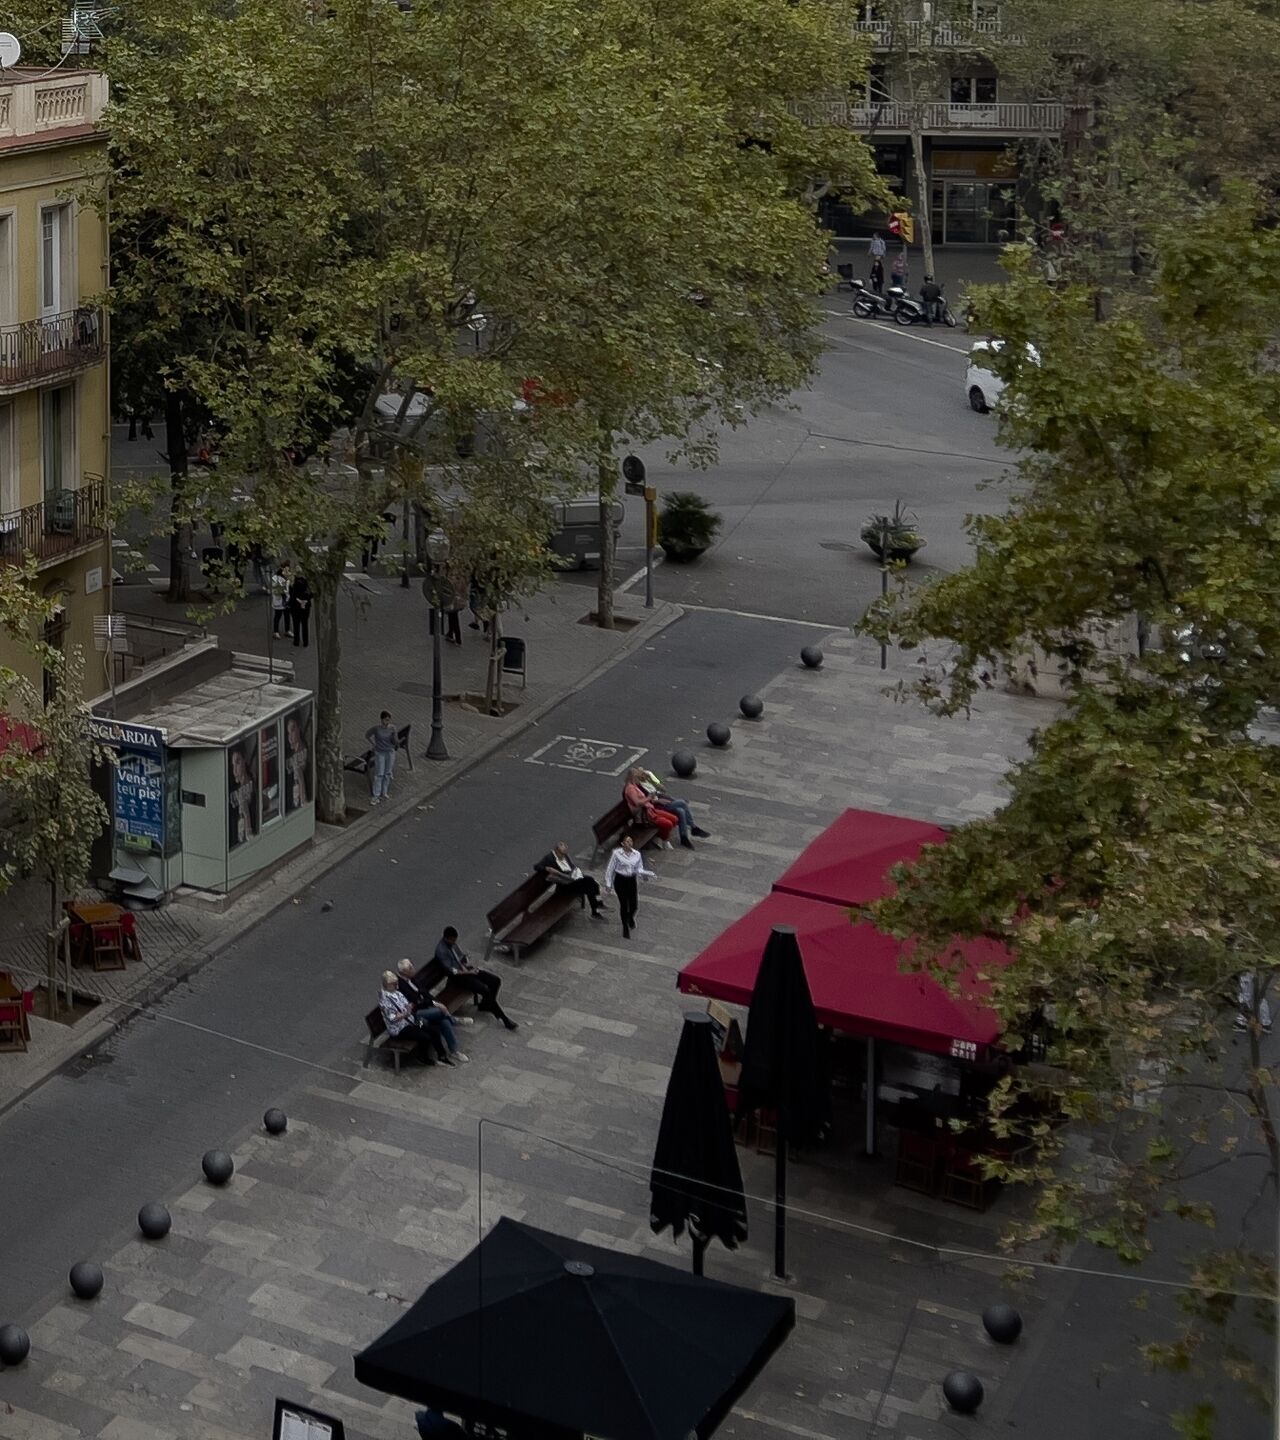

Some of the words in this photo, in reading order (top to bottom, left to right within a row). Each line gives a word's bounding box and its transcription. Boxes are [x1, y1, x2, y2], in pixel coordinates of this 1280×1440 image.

[86, 721, 158, 747] NGUARDIA
[118, 769, 147, 785] Vens
[149, 776, 161, 787] el
[117, 782, 136, 796] teu
[138, 787, 161, 801] pis?
